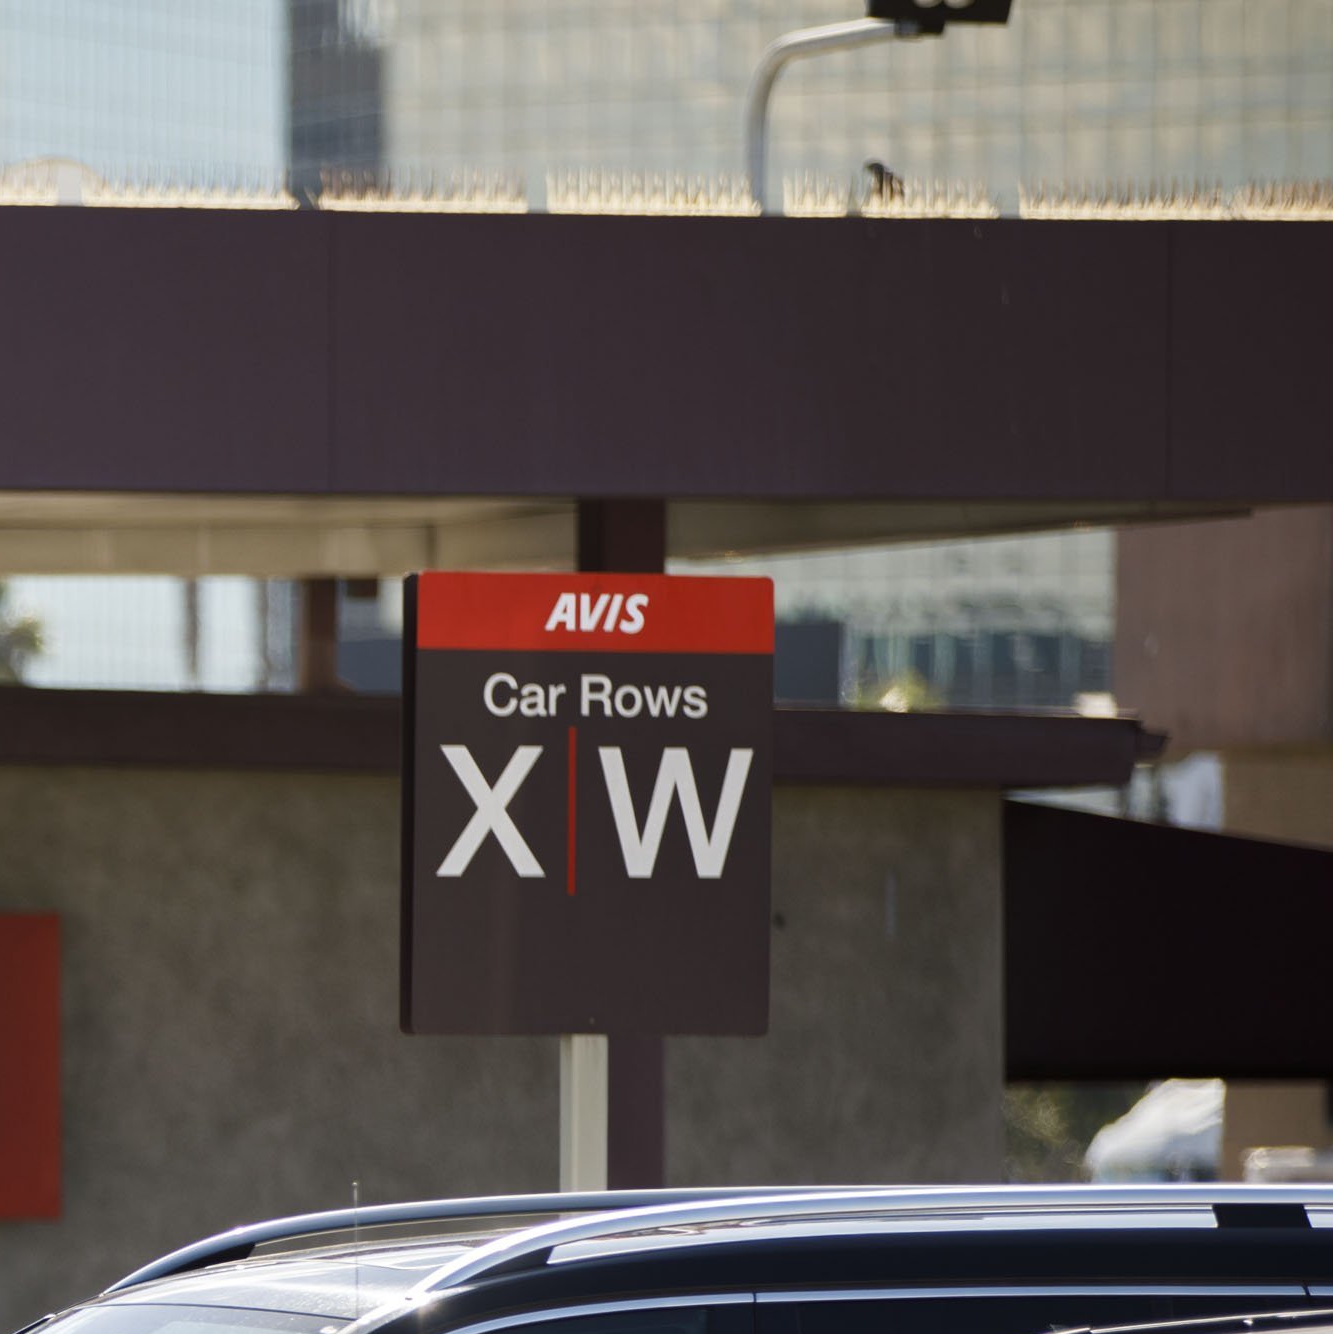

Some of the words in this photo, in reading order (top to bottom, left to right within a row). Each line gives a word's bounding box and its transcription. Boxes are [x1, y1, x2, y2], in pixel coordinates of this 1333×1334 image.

[545, 593, 650, 634] AVIS
[483, 672, 566, 717] Car
[580, 674, 708, 719] Rows
[436, 744, 546, 877] X
[598, 746, 754, 879] W
